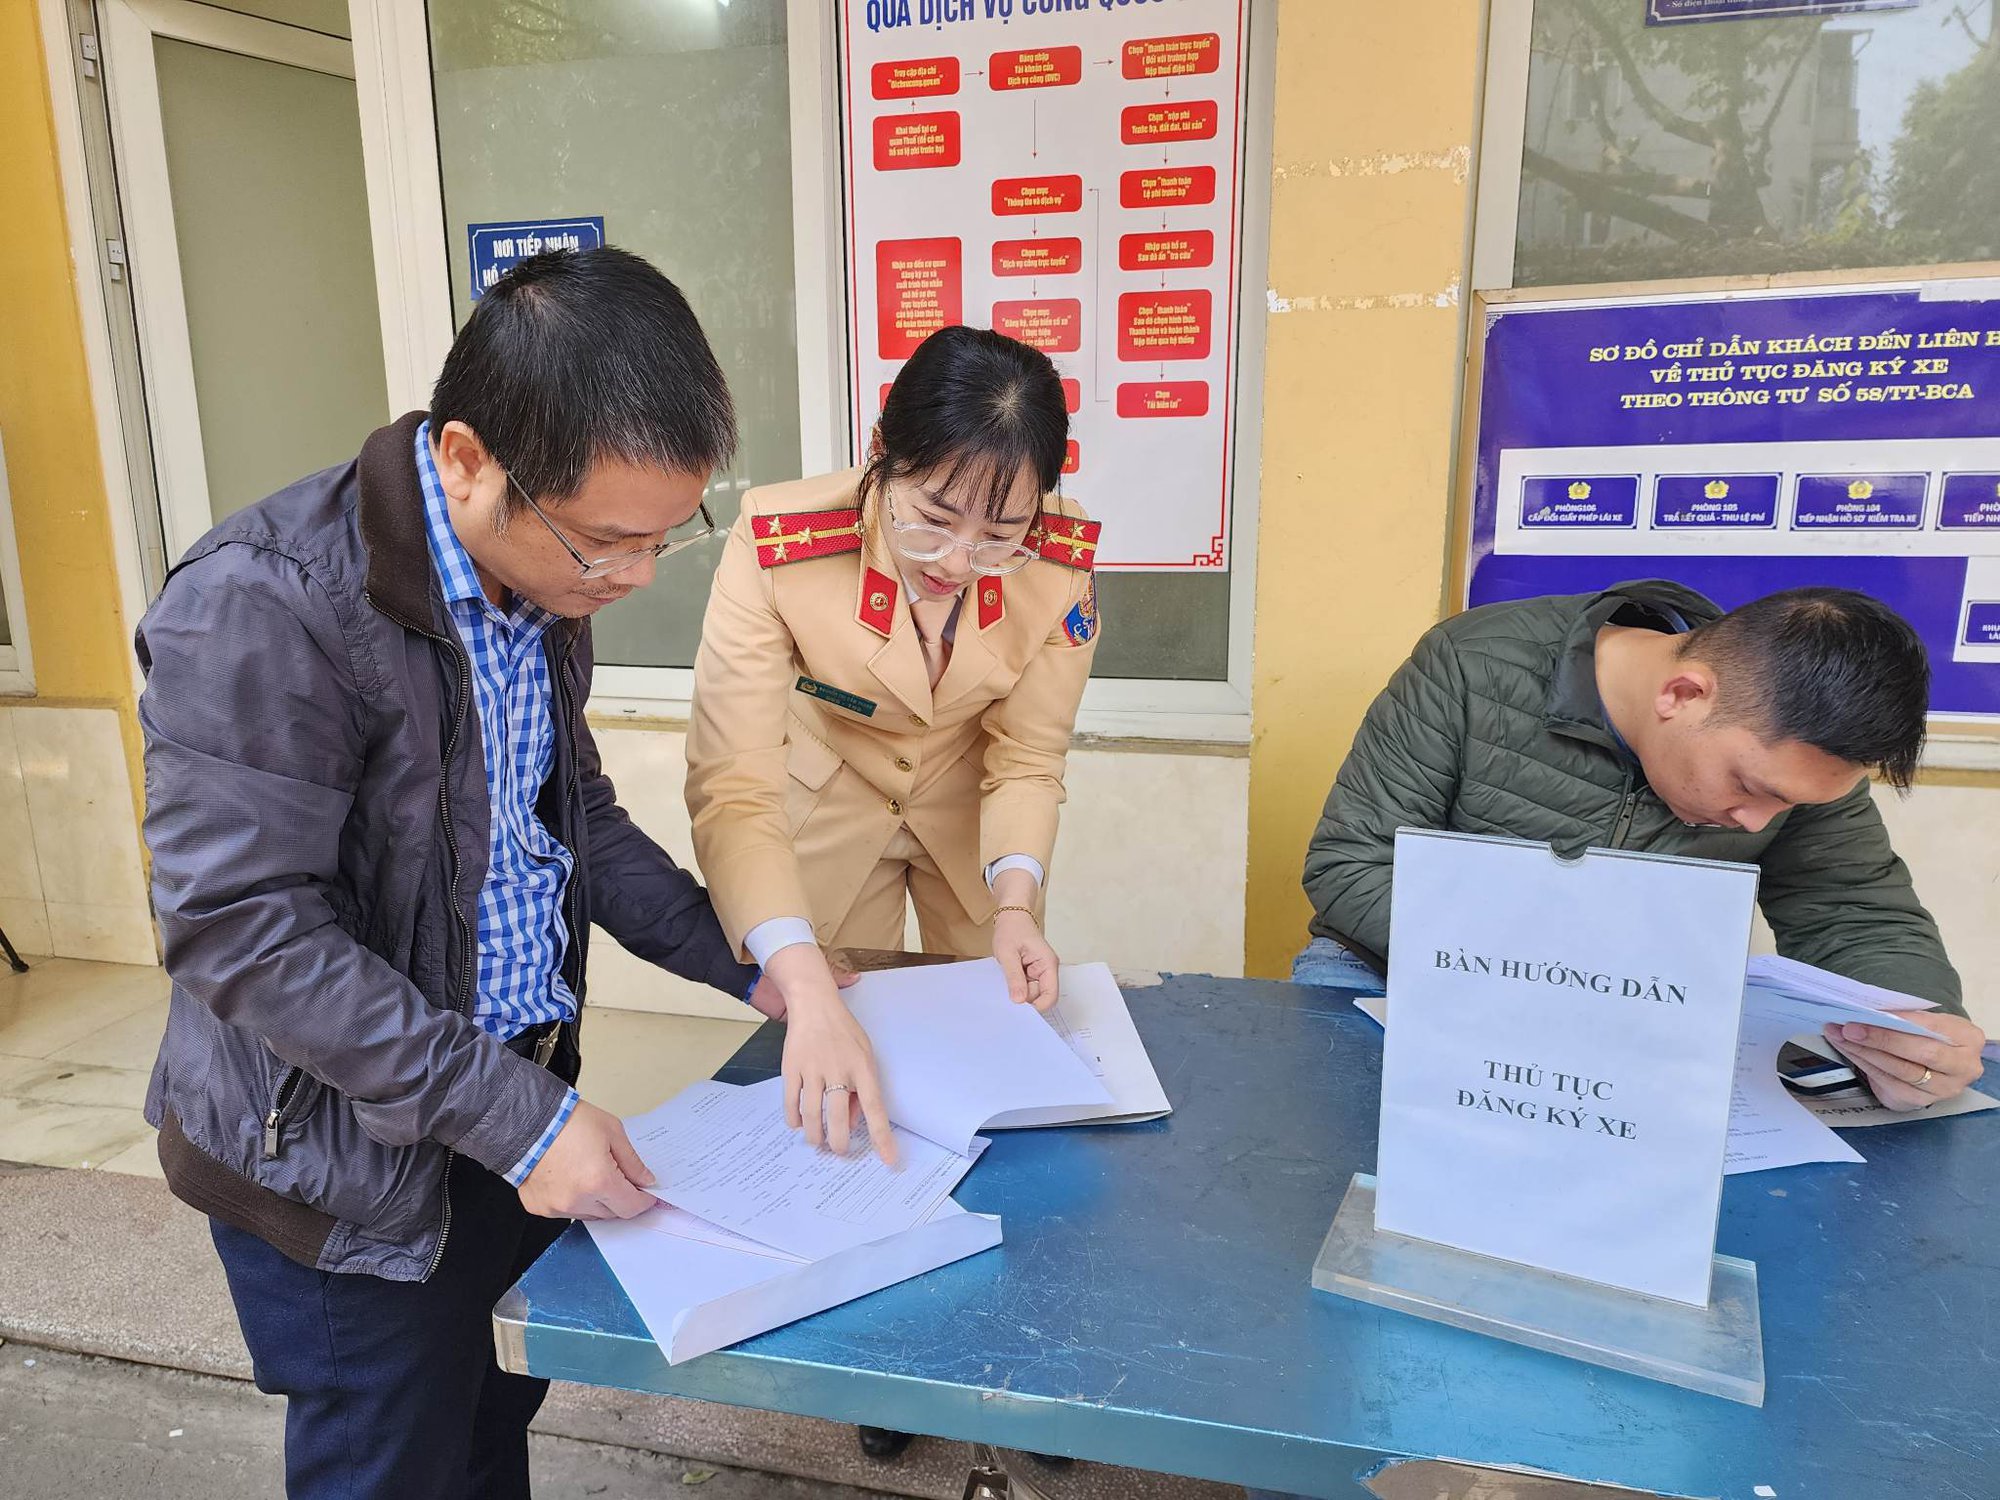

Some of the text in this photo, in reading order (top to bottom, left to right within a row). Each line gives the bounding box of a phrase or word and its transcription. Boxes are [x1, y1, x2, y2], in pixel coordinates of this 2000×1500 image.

[493, 239, 514, 258] NƠI
[516, 232, 541, 256] TIẾP
[1590, 345, 1620, 362] SƠ
[1624, 338, 1658, 360] ĐỒ
[1662, 337, 1704, 358] CHỈ
[1709, 334, 1761, 357] DẪN
[1766, 334, 1853, 354] KHÁCH
[1858, 328, 1912, 351] ĐẾN
[1918, 327, 1981, 349] LIÊN
[1650, 356, 1949, 384] VỀ THỦ TỤC ĐĂNG KÝ XE
[1621, 381, 1974, 409] THEO THÔNG TƯ SỐ 58/TT-BCA
[1964, 512, 1984, 522] TIẾP
[1434, 948, 1687, 1005] BÀN HƯỚNG DẪN
[1483, 1060, 1614, 1100] THỦ TỤC
[1458, 1089, 1637, 1140] ĐĂNG KÝ XE
